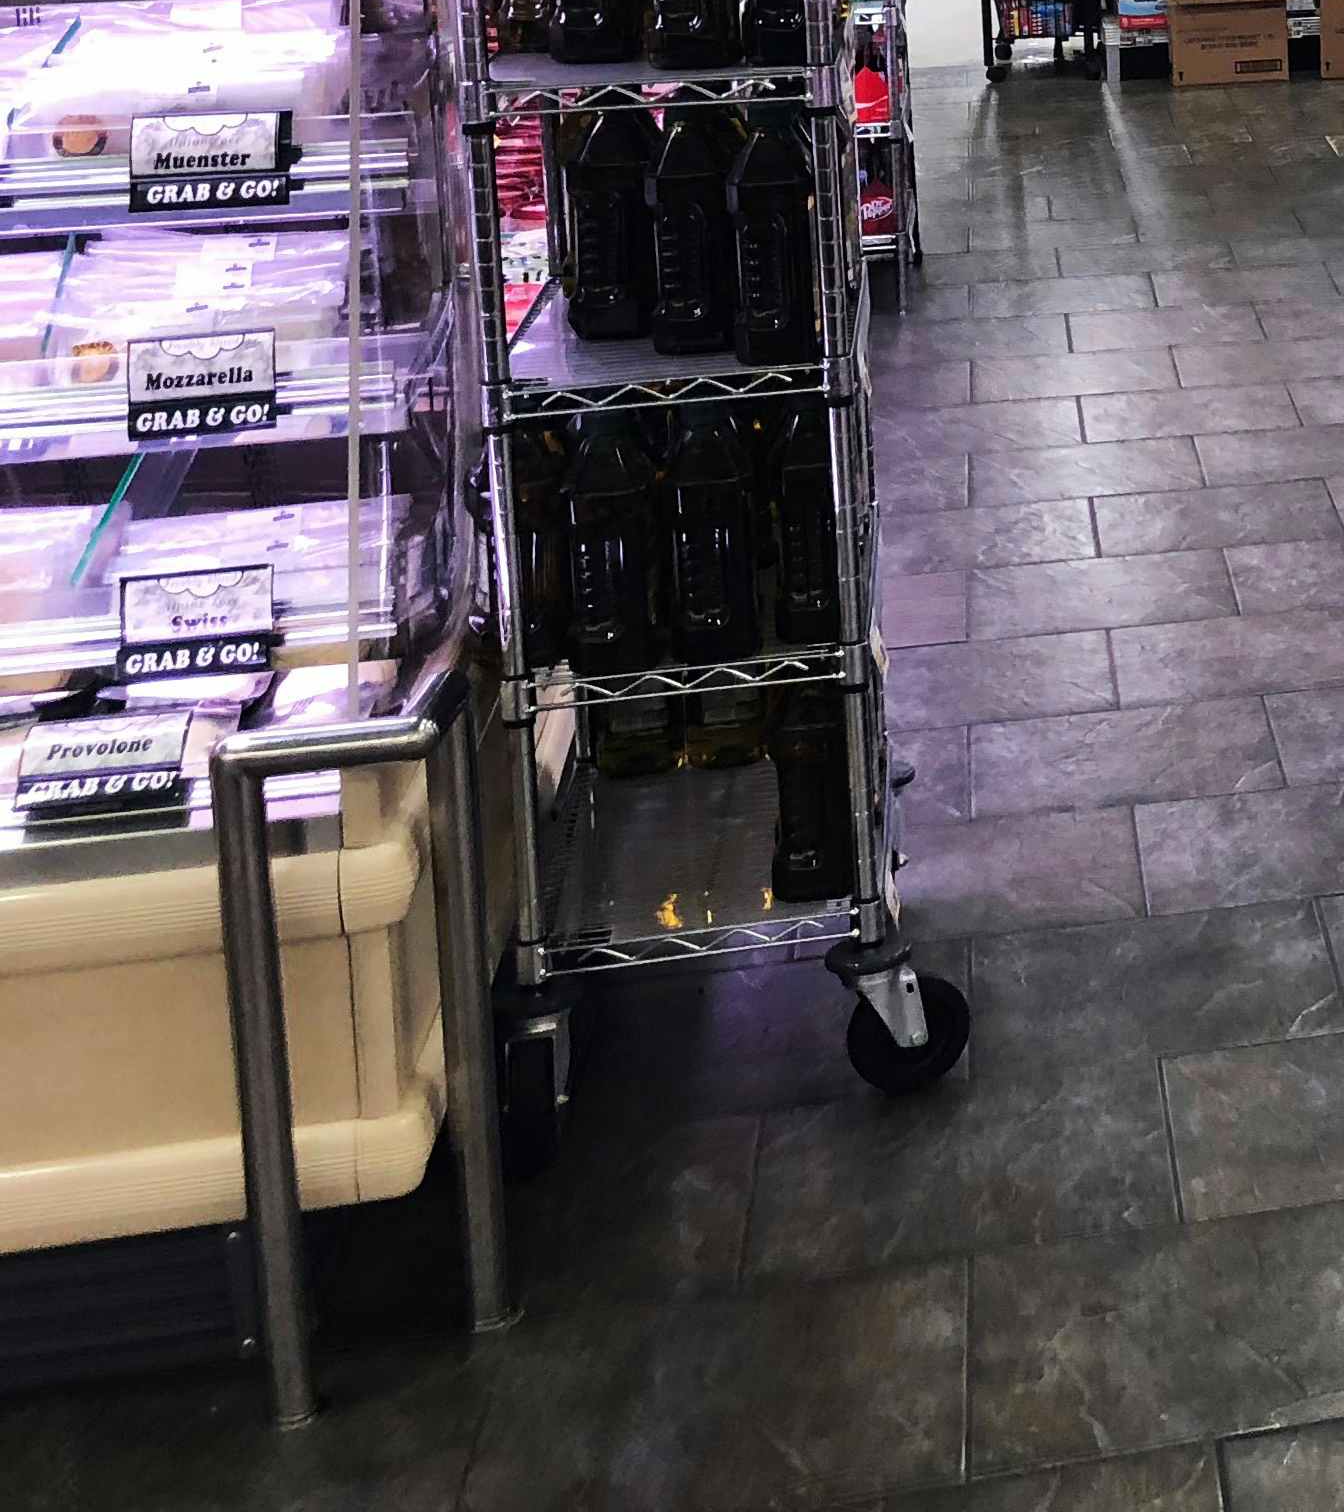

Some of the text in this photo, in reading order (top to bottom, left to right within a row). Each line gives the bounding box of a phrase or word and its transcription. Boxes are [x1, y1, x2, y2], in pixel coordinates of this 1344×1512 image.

[154, 151, 250, 170] Muenster
[147, 180, 279, 204] GRAB & GO!
[145, 366, 254, 392] Mozzarella
[137, 404, 270, 432] GRAB & GO!
[47, 735, 154, 762] Provolone
